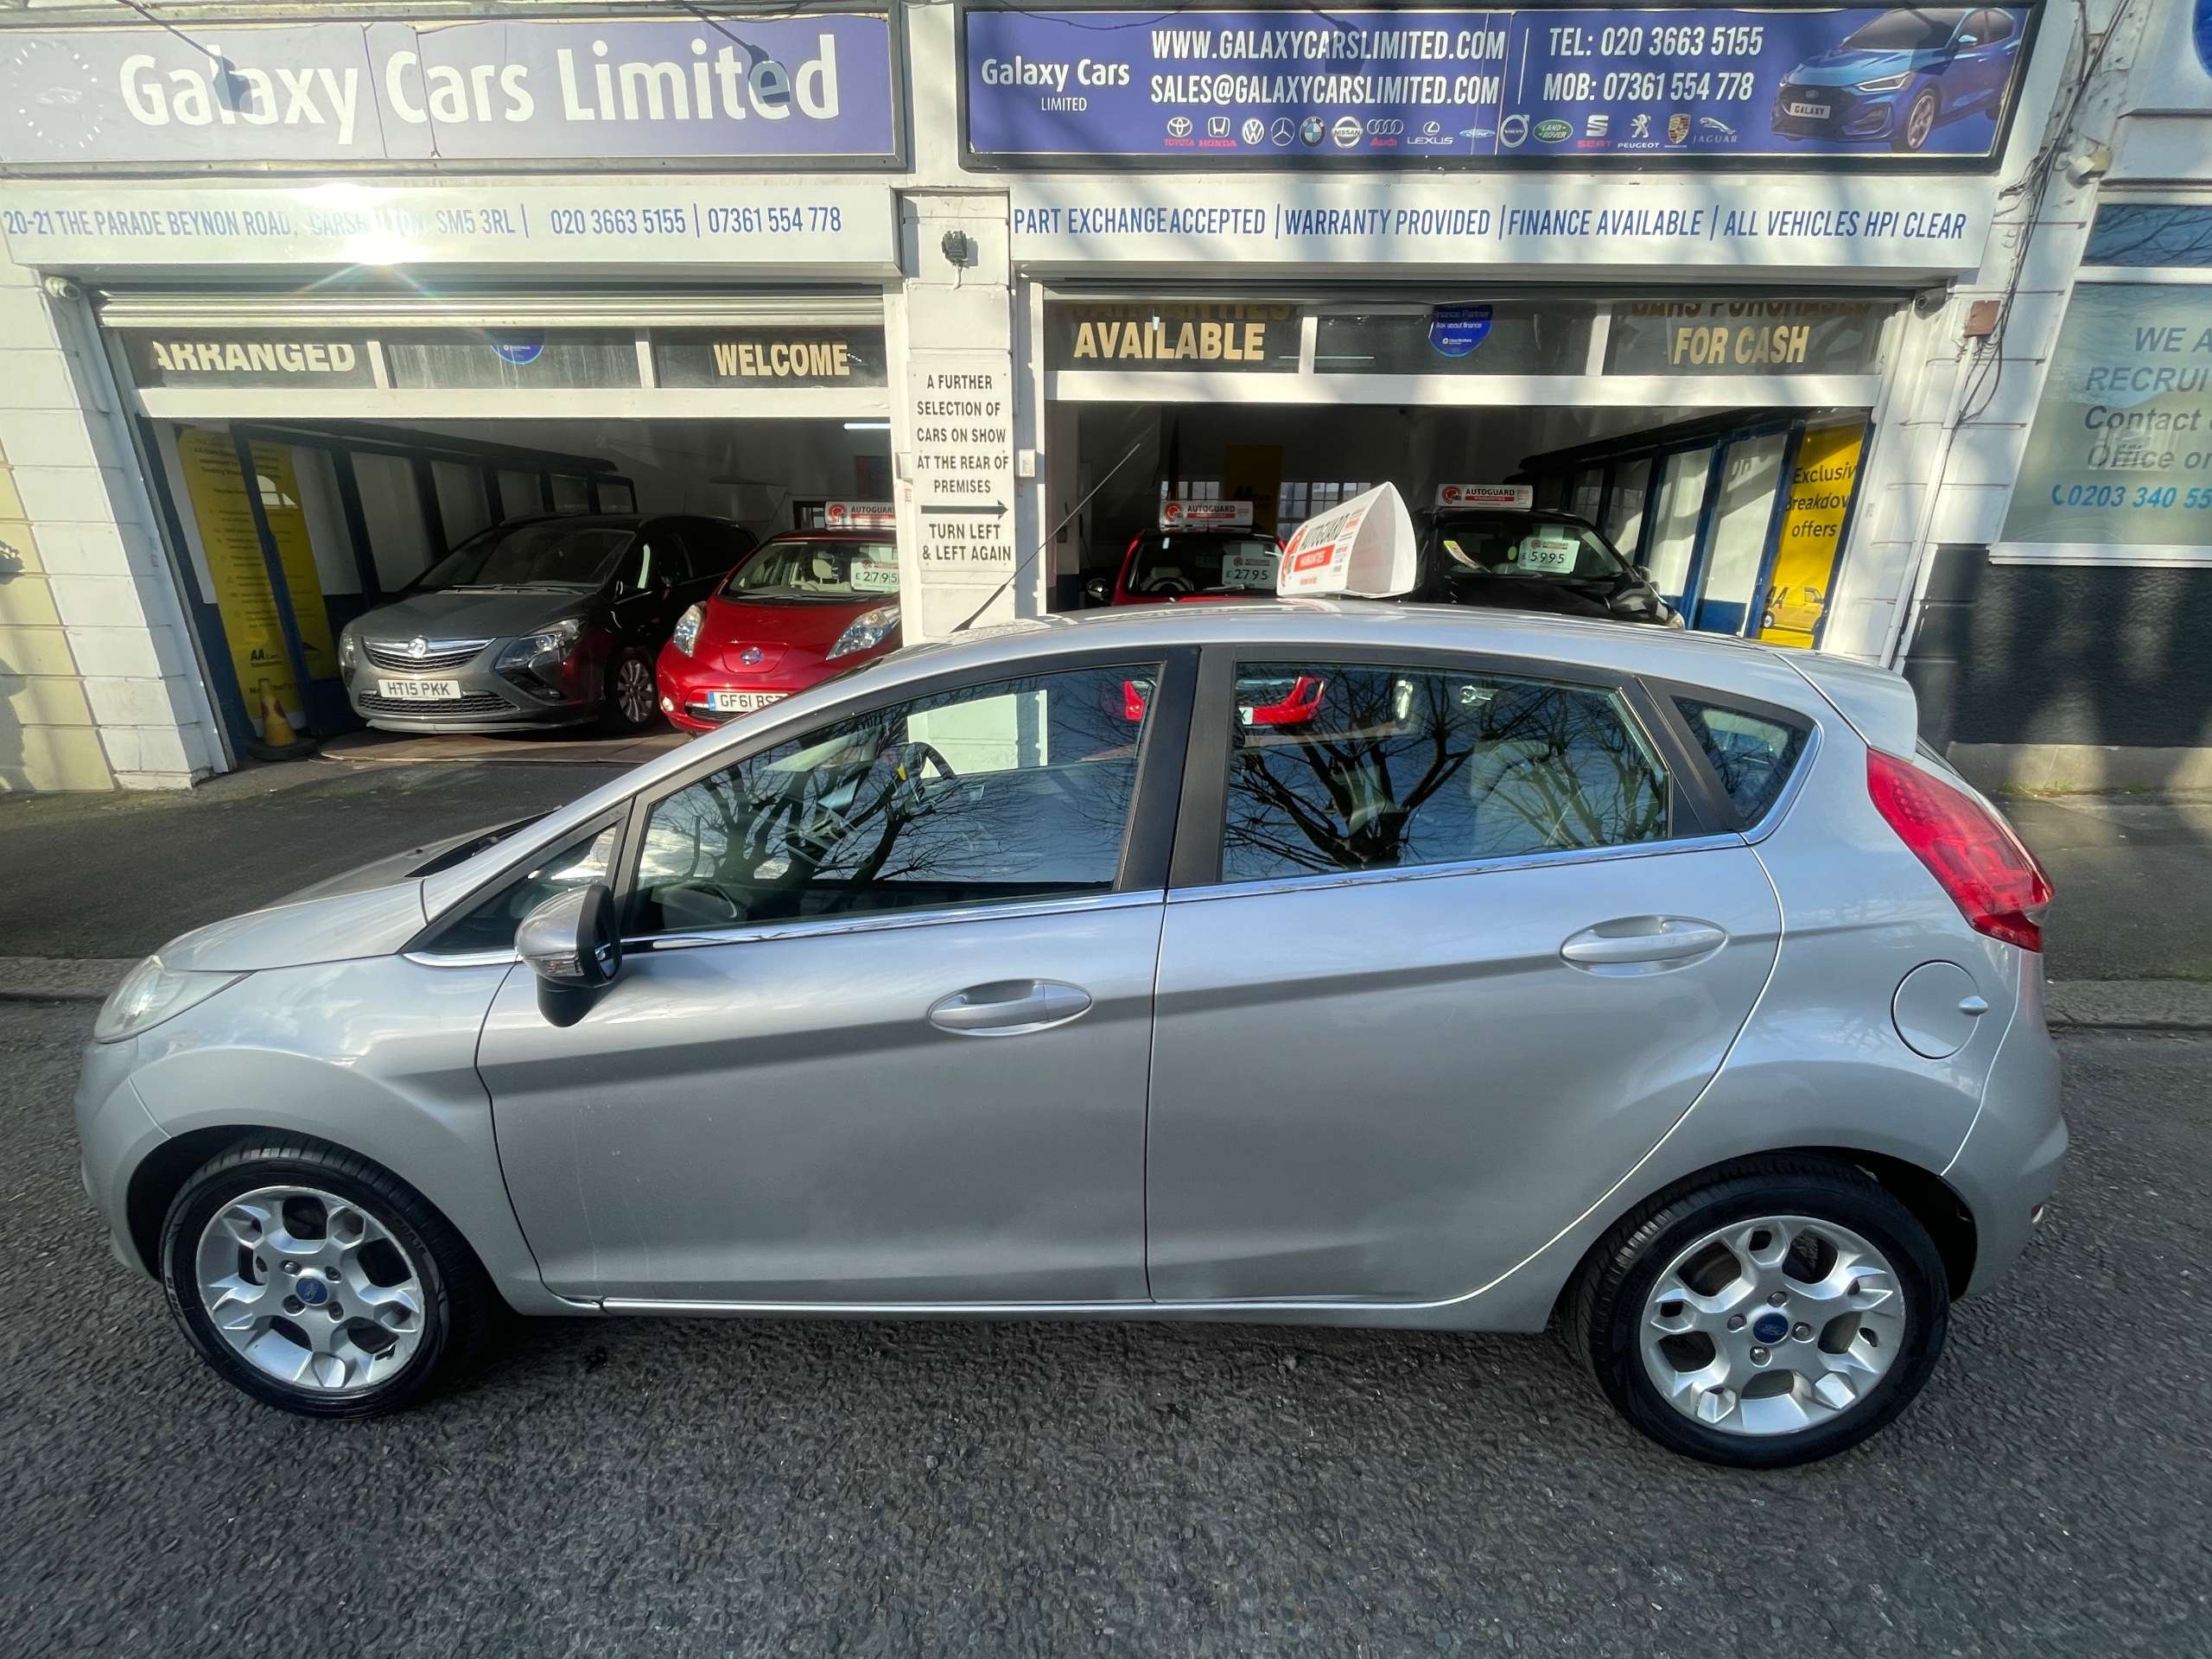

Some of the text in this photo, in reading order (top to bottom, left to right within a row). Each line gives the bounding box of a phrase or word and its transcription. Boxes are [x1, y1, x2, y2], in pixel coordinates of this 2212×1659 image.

[1151, 29, 1506, 60] WWW.GALAXYCARSLIMITED.COM
[1549, 26, 1764, 57] TEL: 020 3663 5155
[981, 55, 1131, 92] Galaxy Cars
[119, 34, 840, 145] Galaxy Cars Limited
[1150, 73, 1500, 105] SALES@GALAXYCARSLIMITED.COM
[1542, 72, 1755, 102] MOB: 07361 554 778
[1040, 97, 1088, 112] LIMITED
[1795, 105, 1825, 116] GALAXY
[1198, 139, 1237, 148] HONDA
[1370, 137, 1397, 147] Audi
[1407, 137, 1454, 145] LEXUS
[1693, 135, 1738, 144] JAGUAR
[3, 210, 54, 236] 20-21
[56, 210, 93, 236] THE
[93, 210, 166, 236] PARADE
[167, 210, 240, 236] BEYNON
[245, 209, 299, 238] ROAD,
[435, 209, 477, 235] SM5
[480, 208, 517, 234] 3RL
[550, 207, 686, 235] 020 3663 5155
[707, 206, 842, 233] 07361 554 778
[1014, 207, 1266, 235] PART EXCHANGE ACCEPTED
[1285, 209, 1491, 236] WARRANTY PROVIDED
[1508, 209, 1704, 237] FINANCE AVAILABLE
[1723, 210, 1967, 239] ALL VEHICLES HPI CLEAR
[1073, 322, 1266, 360] AVAILABLE
[1673, 326, 1811, 365] FOR CASH
[2135, 327, 2187, 353] WE
[152, 341, 356, 372] ARRANGED
[714, 343, 850, 377] WELCOME
[927, 374, 993, 390] A FURTHER
[2085, 366, 2209, 392] RECRUI
[917, 401, 1001, 416] SELECTION OF
[2084, 404, 2202, 431] Contact
[917, 427, 1007, 443] CARS ON SHOW
[917, 454, 1009, 470] AT THE REAR OF
[2087, 443, 2175, 470] Office
[934, 479, 991, 493] PREMISES
[2069, 484, 2212, 509] 0203 340 55
[929, 524, 1001, 539] TURN LEFT
[1791, 520, 1837, 537] offers
[922, 545, 1012, 561] & LEFT AGAIN
[387, 682, 451, 696] HT15 PKK
[720, 694, 753, 708] GF61
